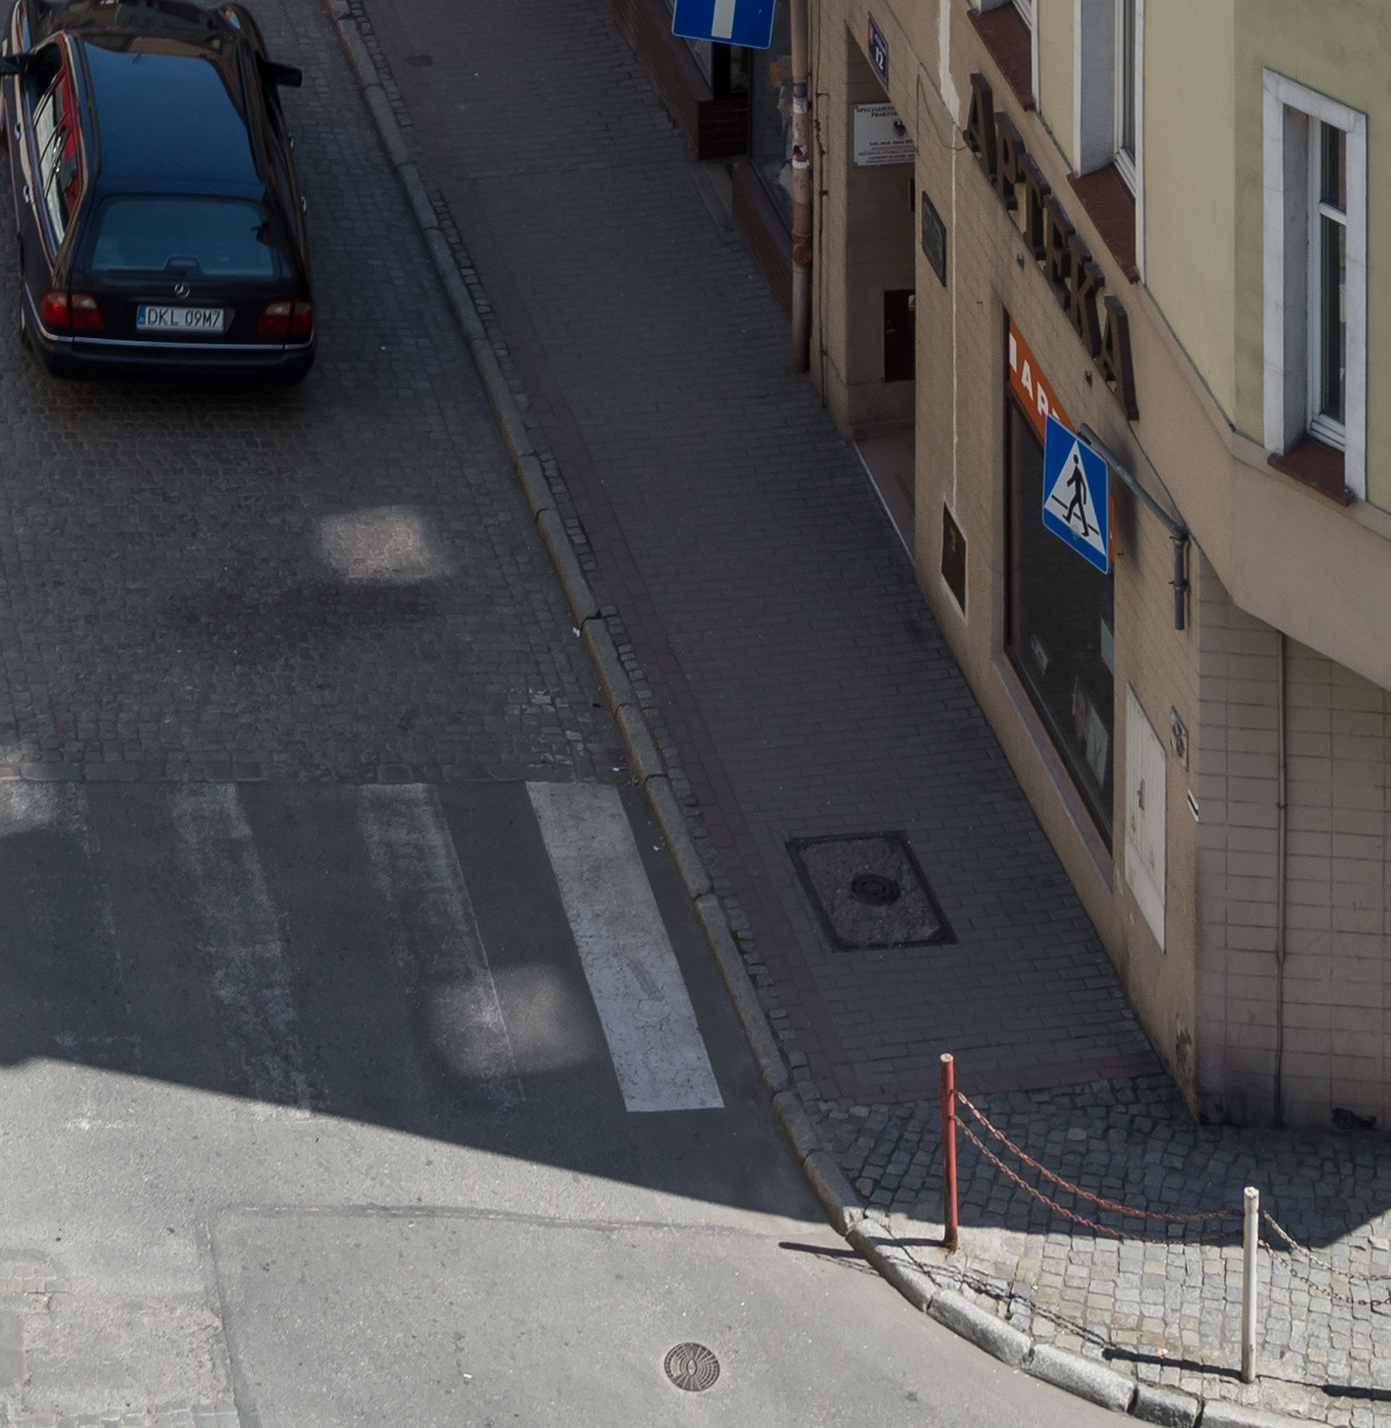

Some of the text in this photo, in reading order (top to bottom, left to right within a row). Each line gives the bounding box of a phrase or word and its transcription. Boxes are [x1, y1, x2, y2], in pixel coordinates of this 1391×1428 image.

[147, 308, 222, 328] DKL 09M7
[962, 72, 1140, 421] APTEKA
